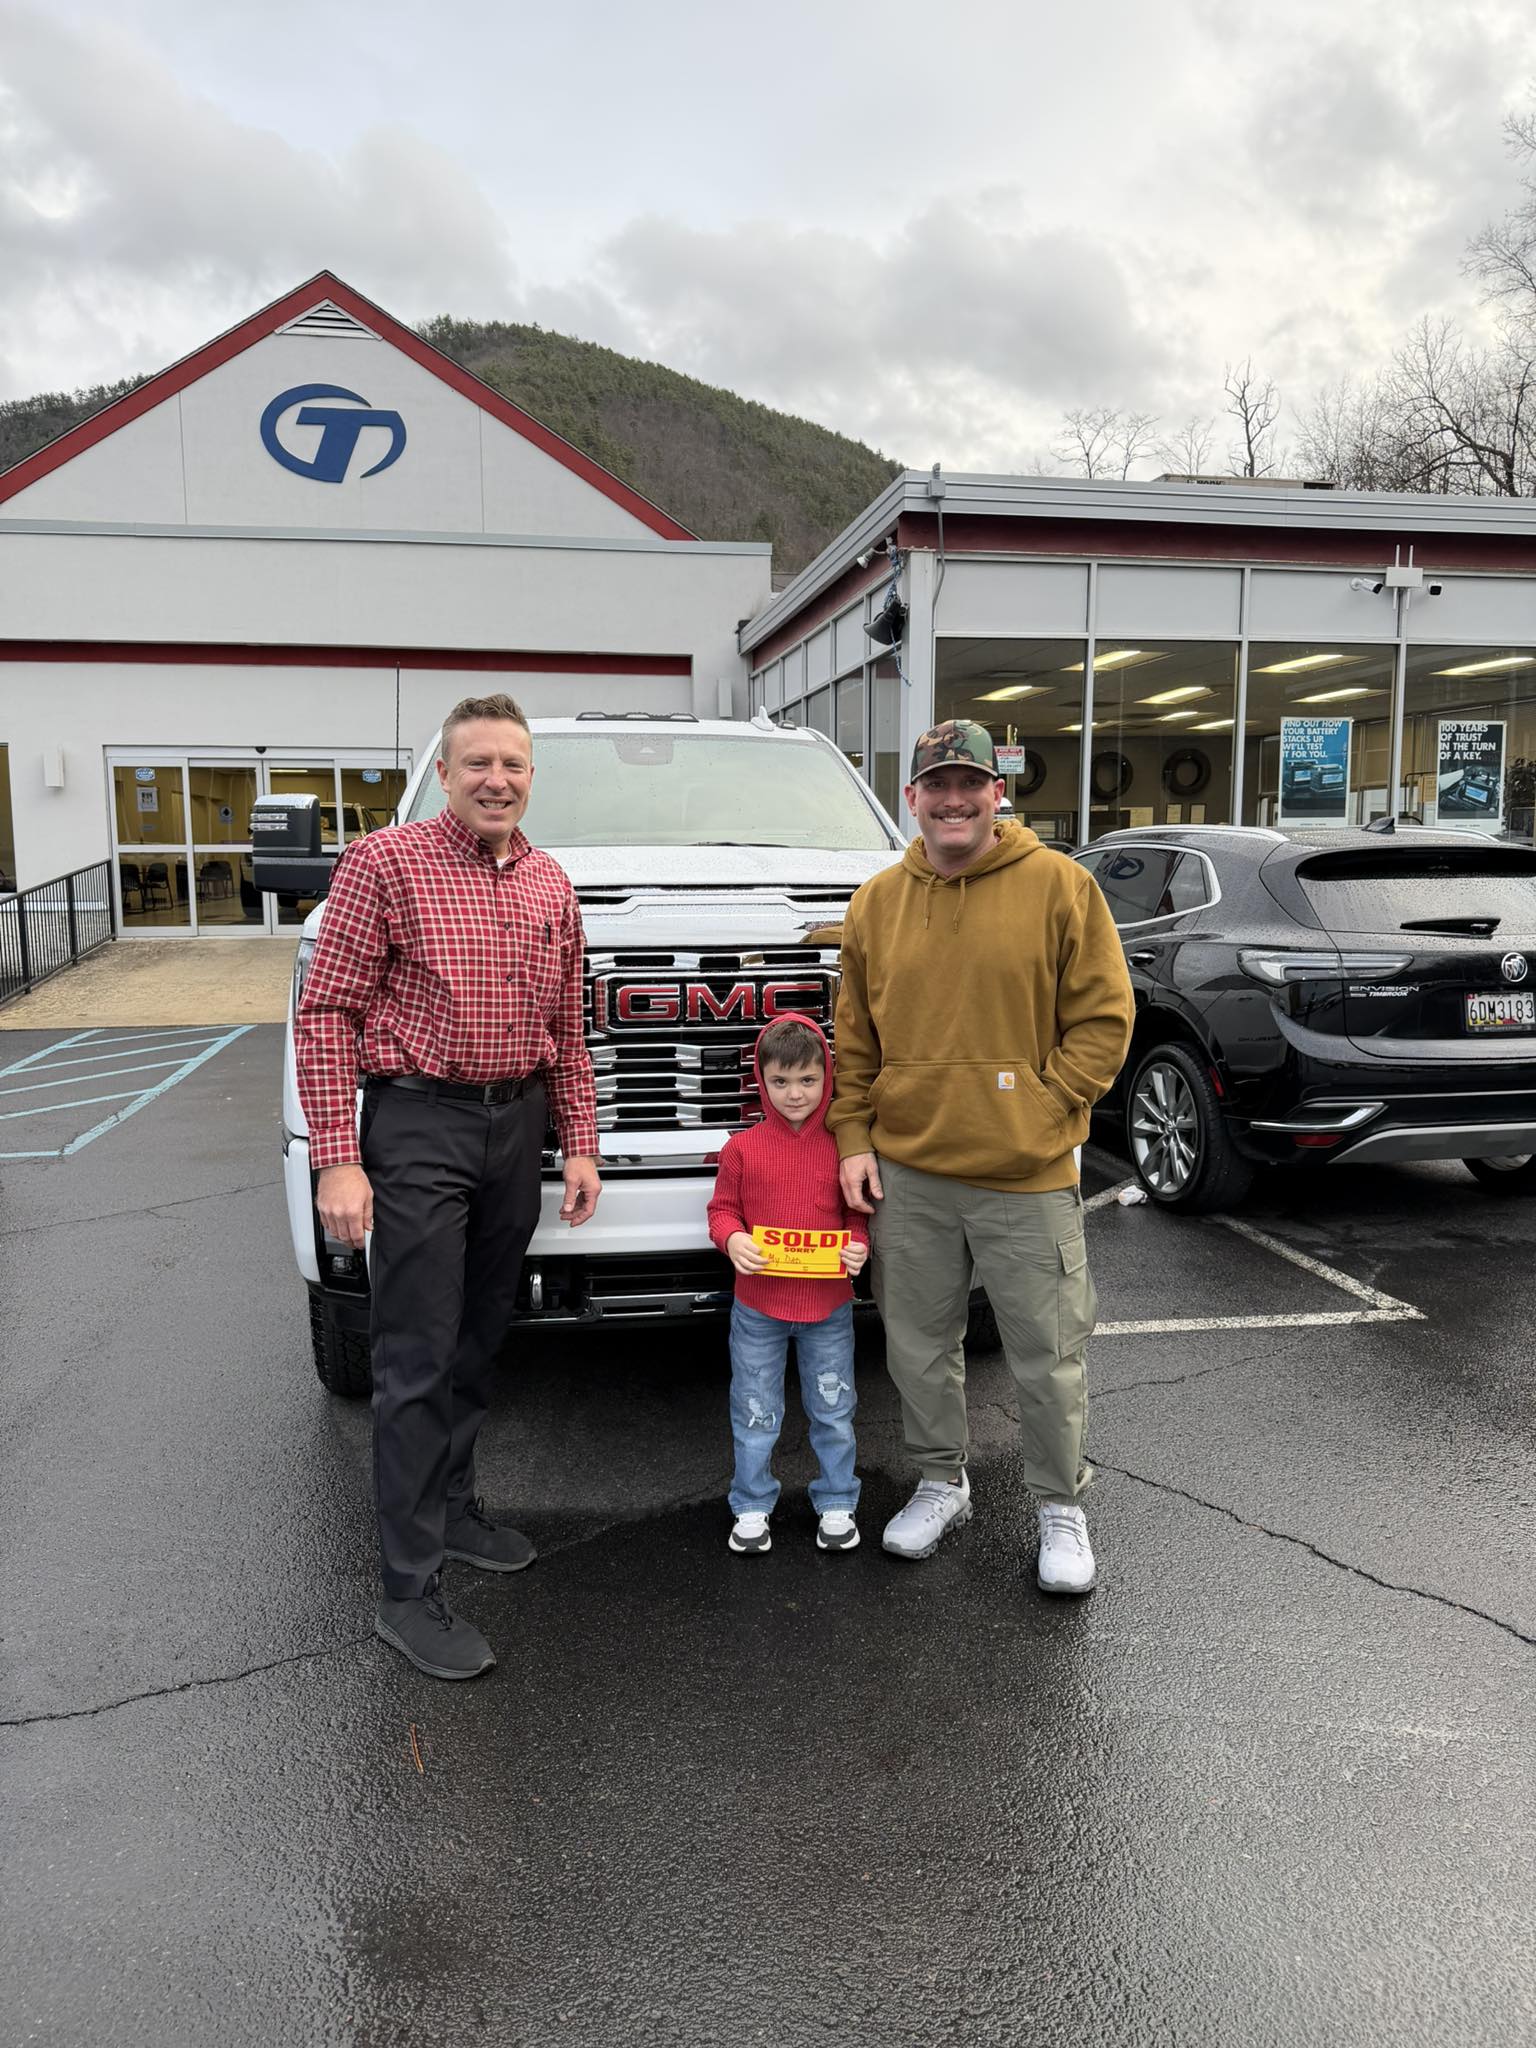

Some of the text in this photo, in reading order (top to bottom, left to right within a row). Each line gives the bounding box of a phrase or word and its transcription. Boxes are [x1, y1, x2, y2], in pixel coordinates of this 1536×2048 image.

[1303, 720, 1320, 728] OUT
[1322, 720, 1342, 728] HOW
[1441, 723, 1488, 732] 100 YEARS
[1283, 727, 1339, 735] YOUR BATTERY
[1283, 735, 1311, 743] STACKS
[1440, 733, 1482, 742] OF TRUST
[1440, 742, 1496, 751] IN THE TURN
[1282, 750, 1328, 758] IT FOR YOU.
[1440, 751, 1482, 760] OF A KEY.
[617, 982, 824, 1021] GMC
[1470, 1000, 1534, 1024] 6DM3183
